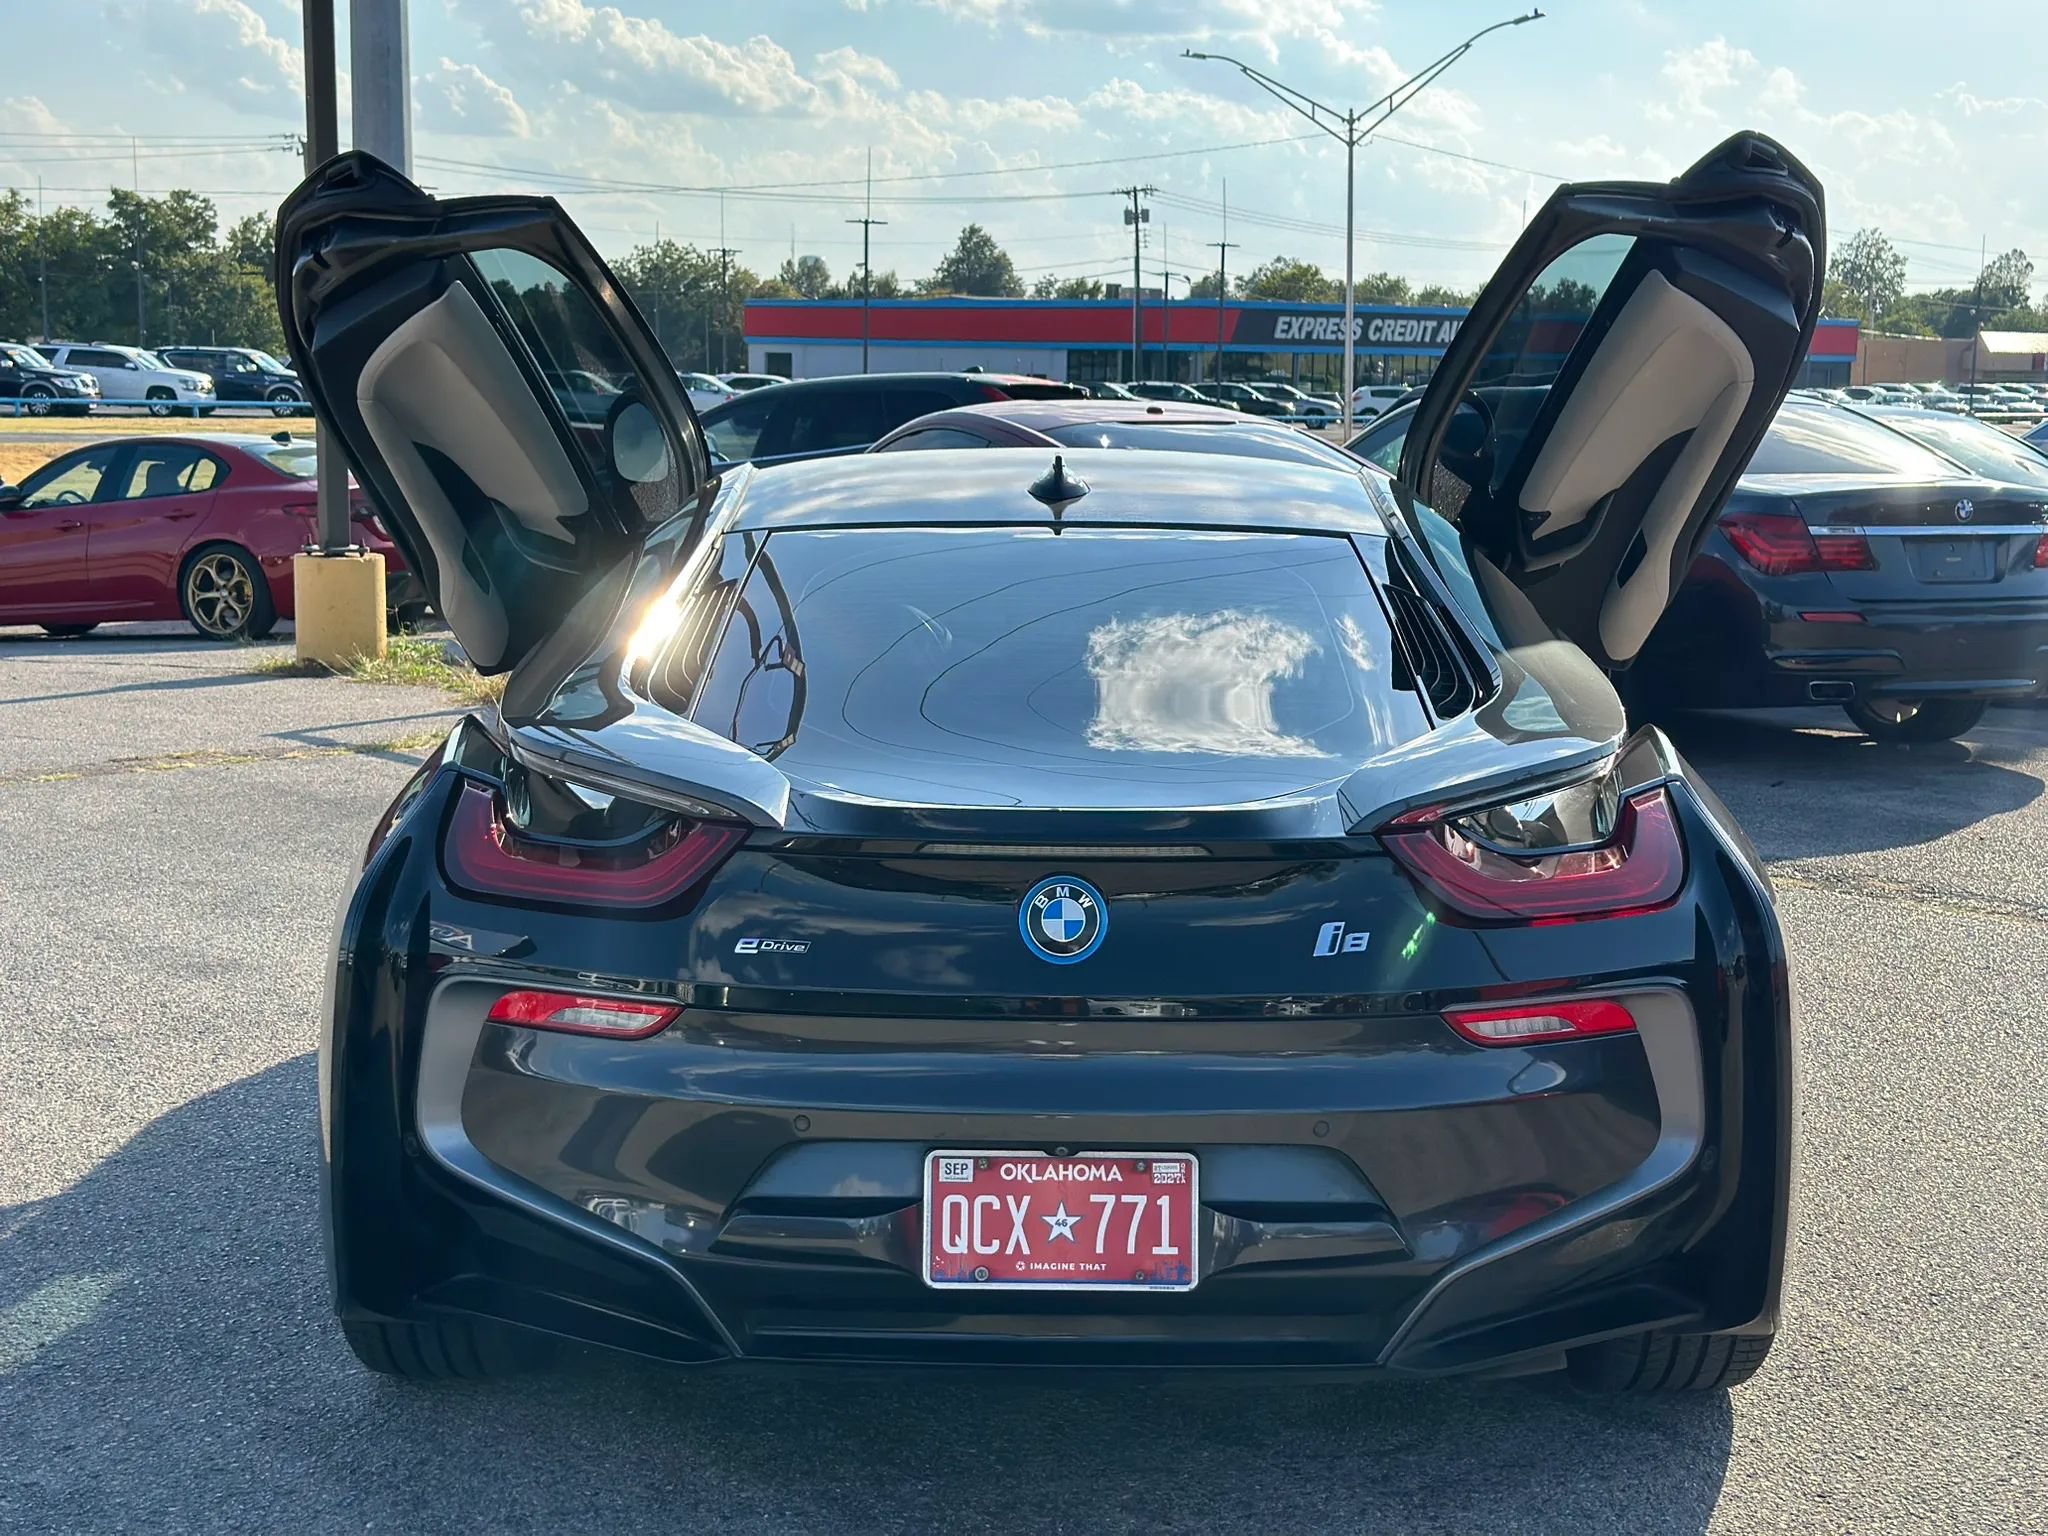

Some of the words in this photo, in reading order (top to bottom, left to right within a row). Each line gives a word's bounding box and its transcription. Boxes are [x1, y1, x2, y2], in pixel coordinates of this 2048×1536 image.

[1273, 315, 1363, 341] EXPRESS
[1367, 319, 1438, 343] CREDIT
[1034, 886, 1093, 909] BMW
[944, 1162, 969, 1175] SEP
[1000, 1163, 1123, 1183] OKLAHOMA
[942, 1194, 1031, 1255] QCX
[1054, 1218, 1068, 1227] 46
[1089, 1194, 1179, 1255] 771
[1030, 1262, 1075, 1271] IMAGINE
[1079, 1263, 1107, 1271] THAT
